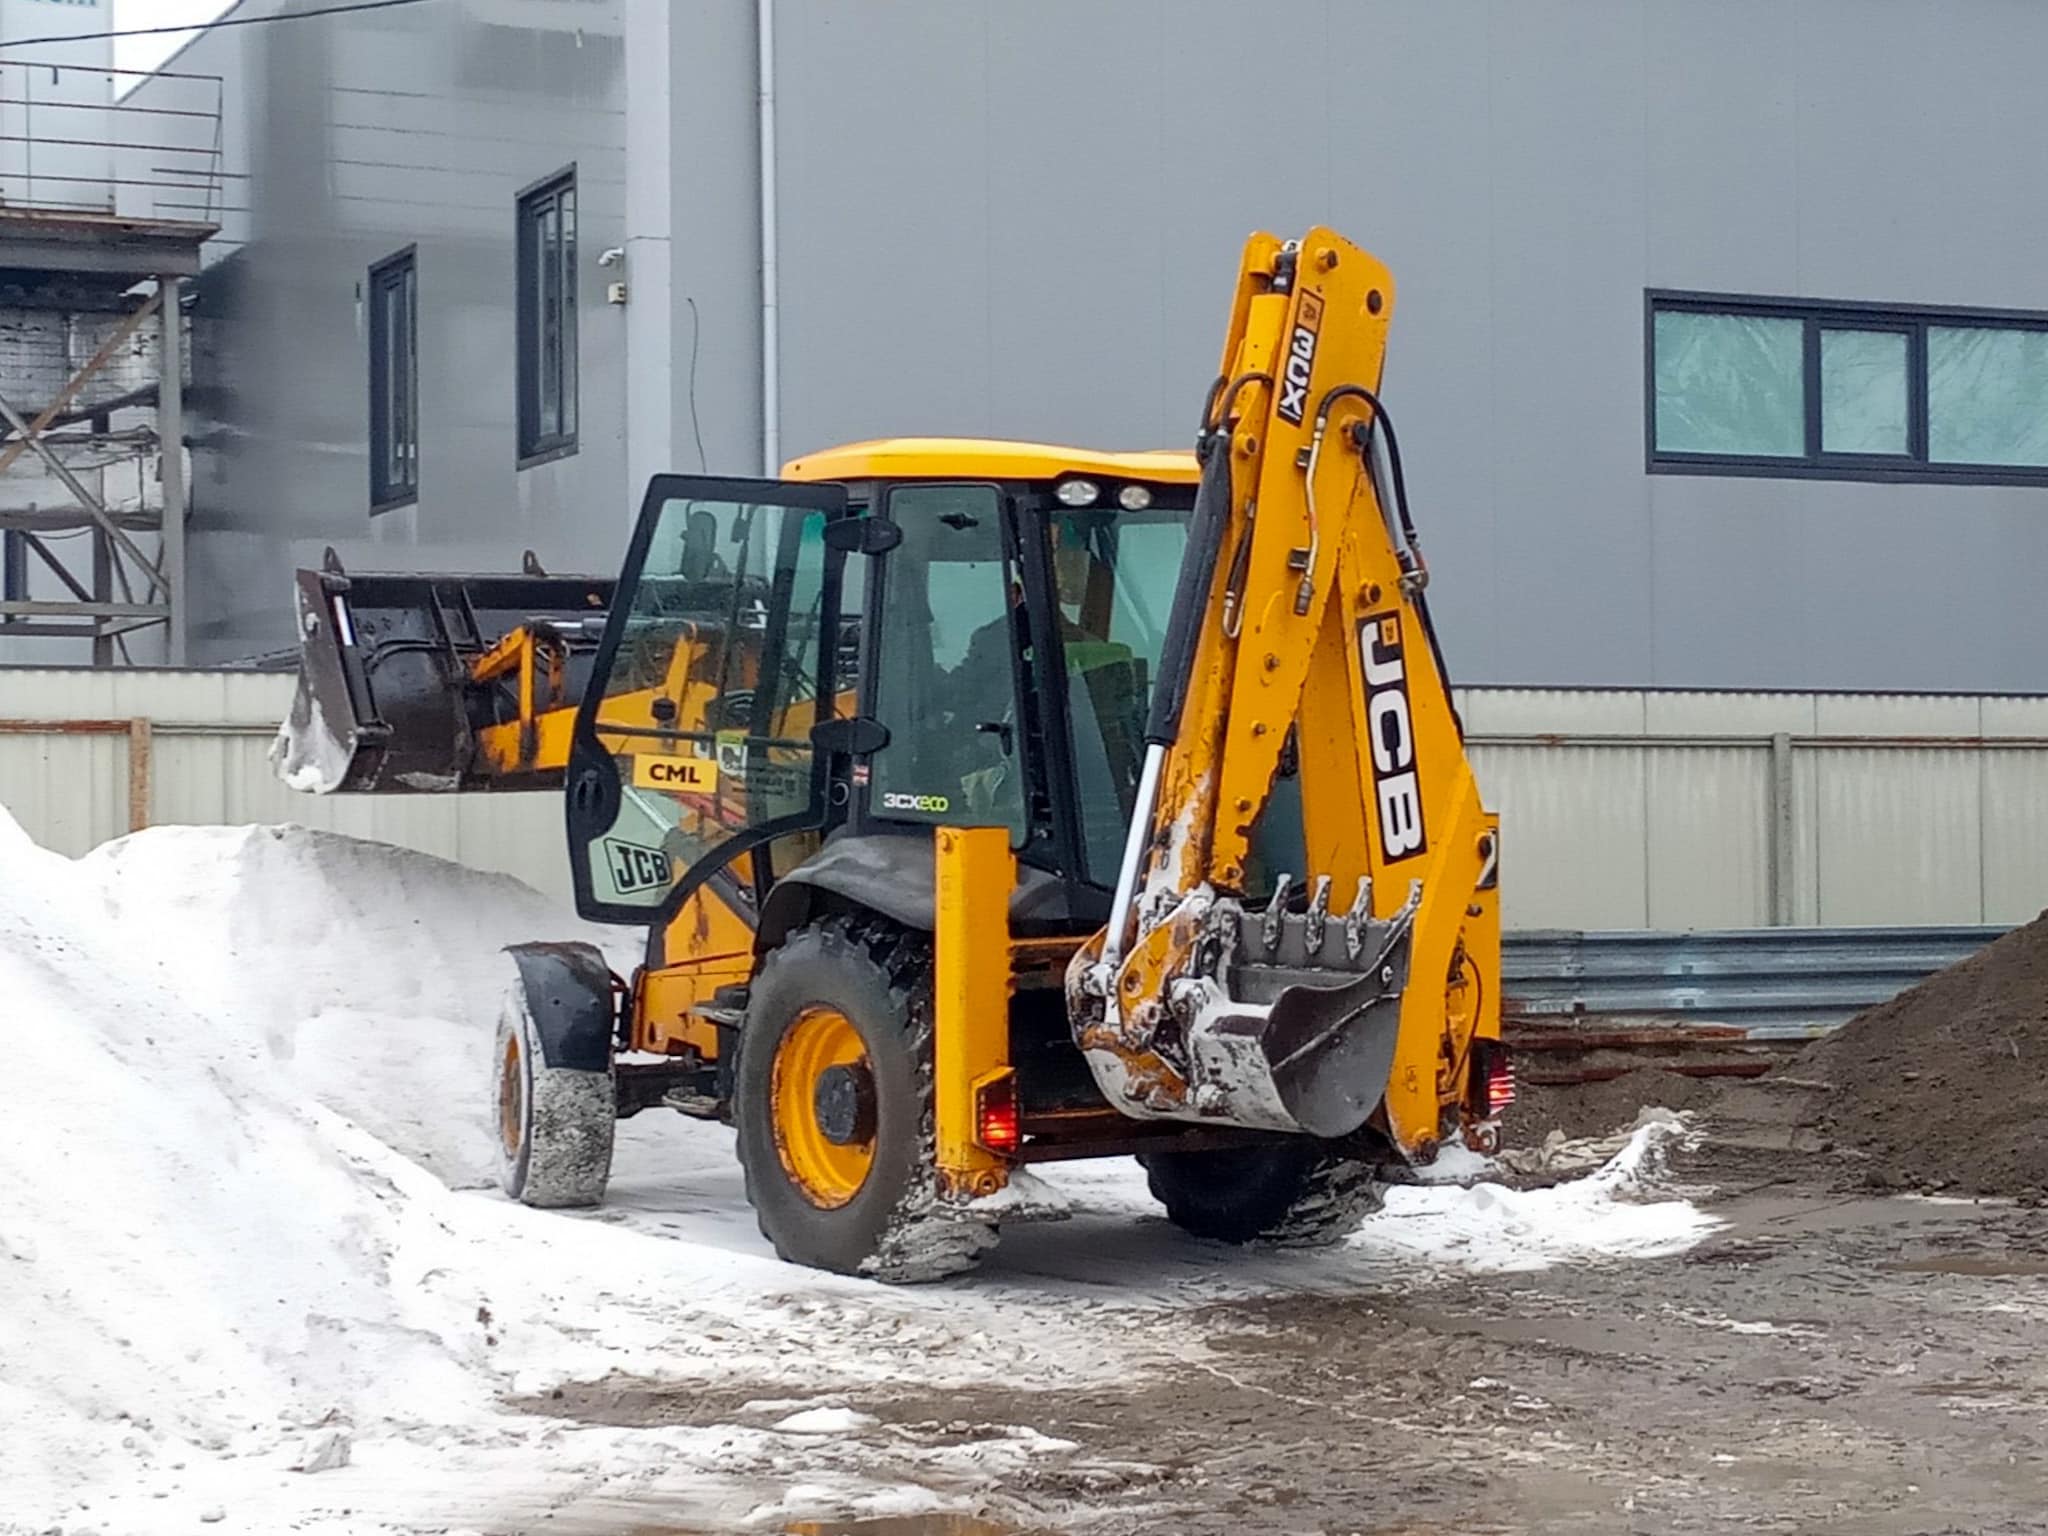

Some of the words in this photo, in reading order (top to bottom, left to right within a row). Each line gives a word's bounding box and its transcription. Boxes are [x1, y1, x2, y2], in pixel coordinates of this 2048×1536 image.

[1279, 326, 1315, 414] 3CX
[1361, 621, 1422, 857] JCB
[649, 763, 701, 784] CML
[615, 845, 670, 889] JCB
